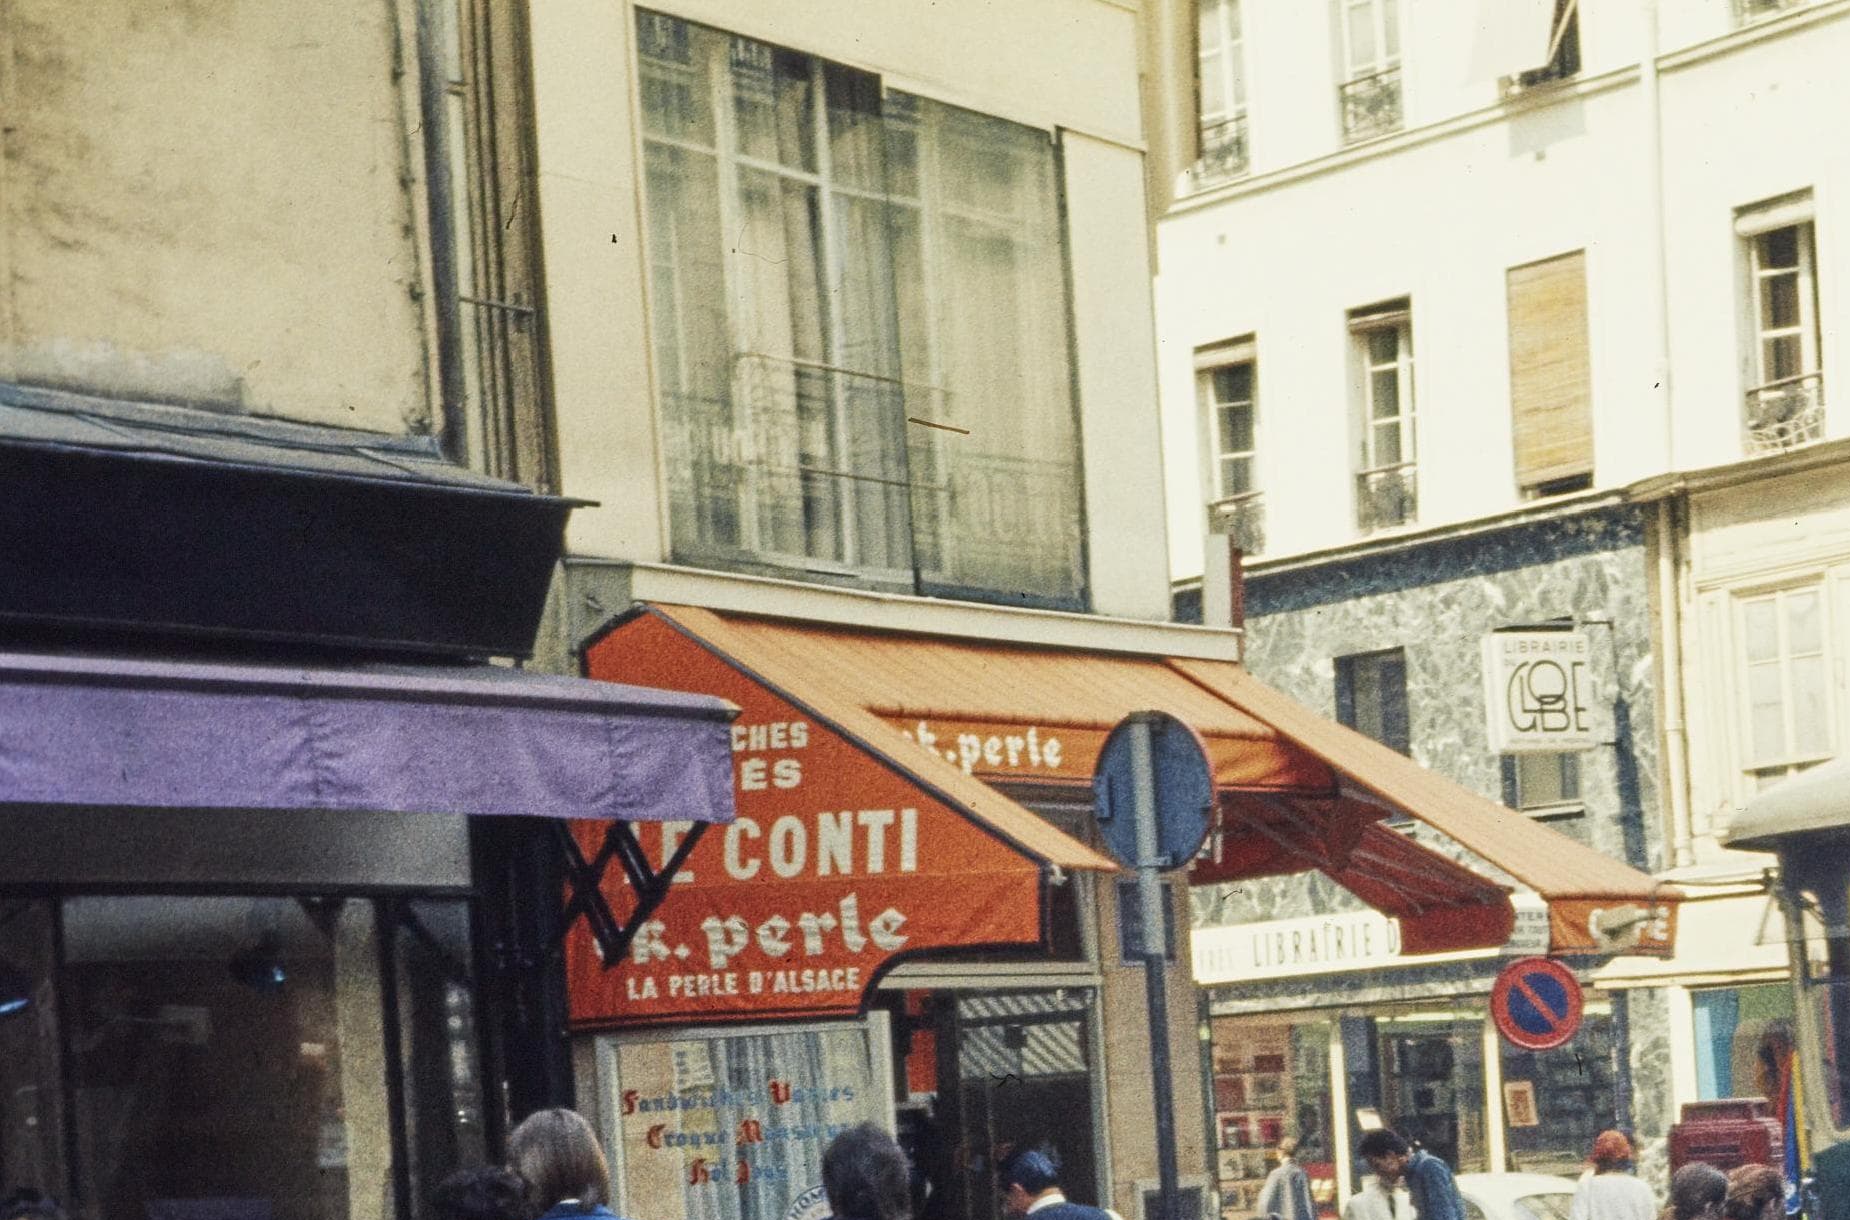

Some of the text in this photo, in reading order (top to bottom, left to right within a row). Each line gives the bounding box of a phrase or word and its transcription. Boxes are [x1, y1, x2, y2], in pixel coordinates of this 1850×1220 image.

[1504, 640, 1585, 654] LIBRAIRIE
[731, 721, 808, 750] CHES
[724, 808, 918, 881] CONTI
[627, 966, 861, 1000] LA PERLE D'ALSACE
